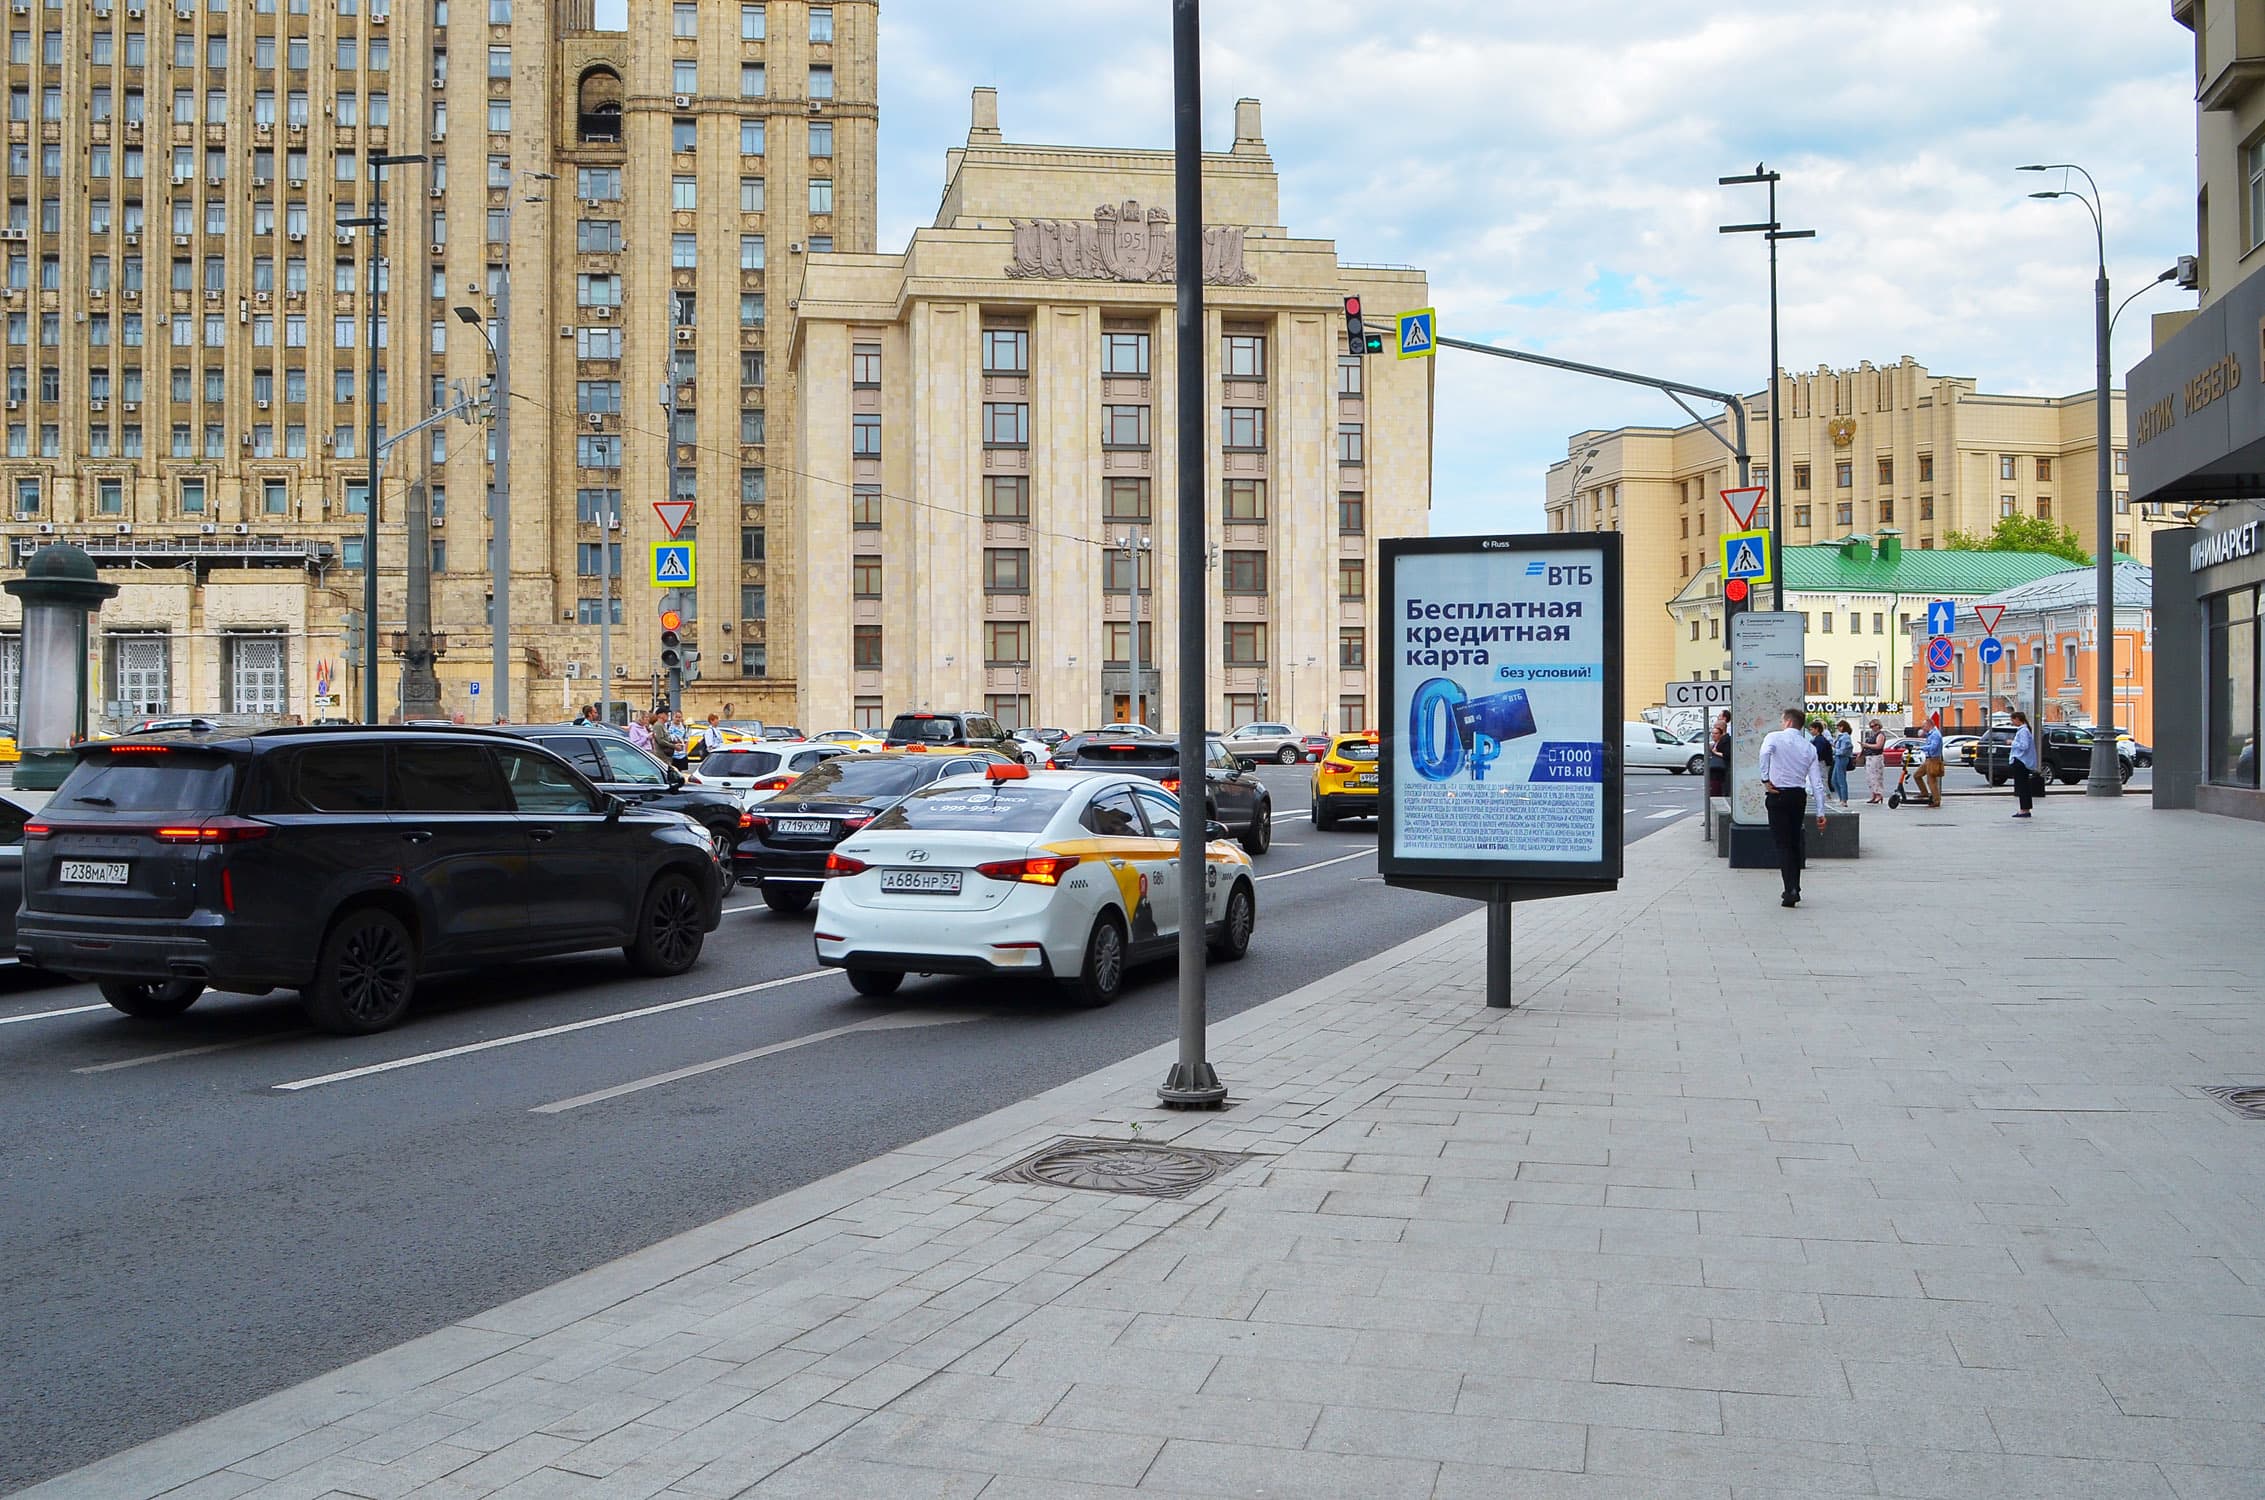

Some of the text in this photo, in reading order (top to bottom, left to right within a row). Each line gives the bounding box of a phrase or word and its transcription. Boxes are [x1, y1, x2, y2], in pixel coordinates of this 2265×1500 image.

[1118, 232, 1147, 250] 1951
[2136, 352, 2241, 448] АНТИК МЕБЕЛЬ
[1490, 540, 1510, 548] Russ
[1548, 565, 1593, 586] ВТБ
[1406, 599, 1583, 620] Бесплатная
[1406, 625, 1571, 649] кредитная
[1406, 648, 1490, 671] карта
[1500, 666, 1592, 681] без условий!
[1676, 685, 1731, 703] СТОП
[1559, 750, 1592, 762] 1000
[1549, 766, 1592, 778] VTB.RU
